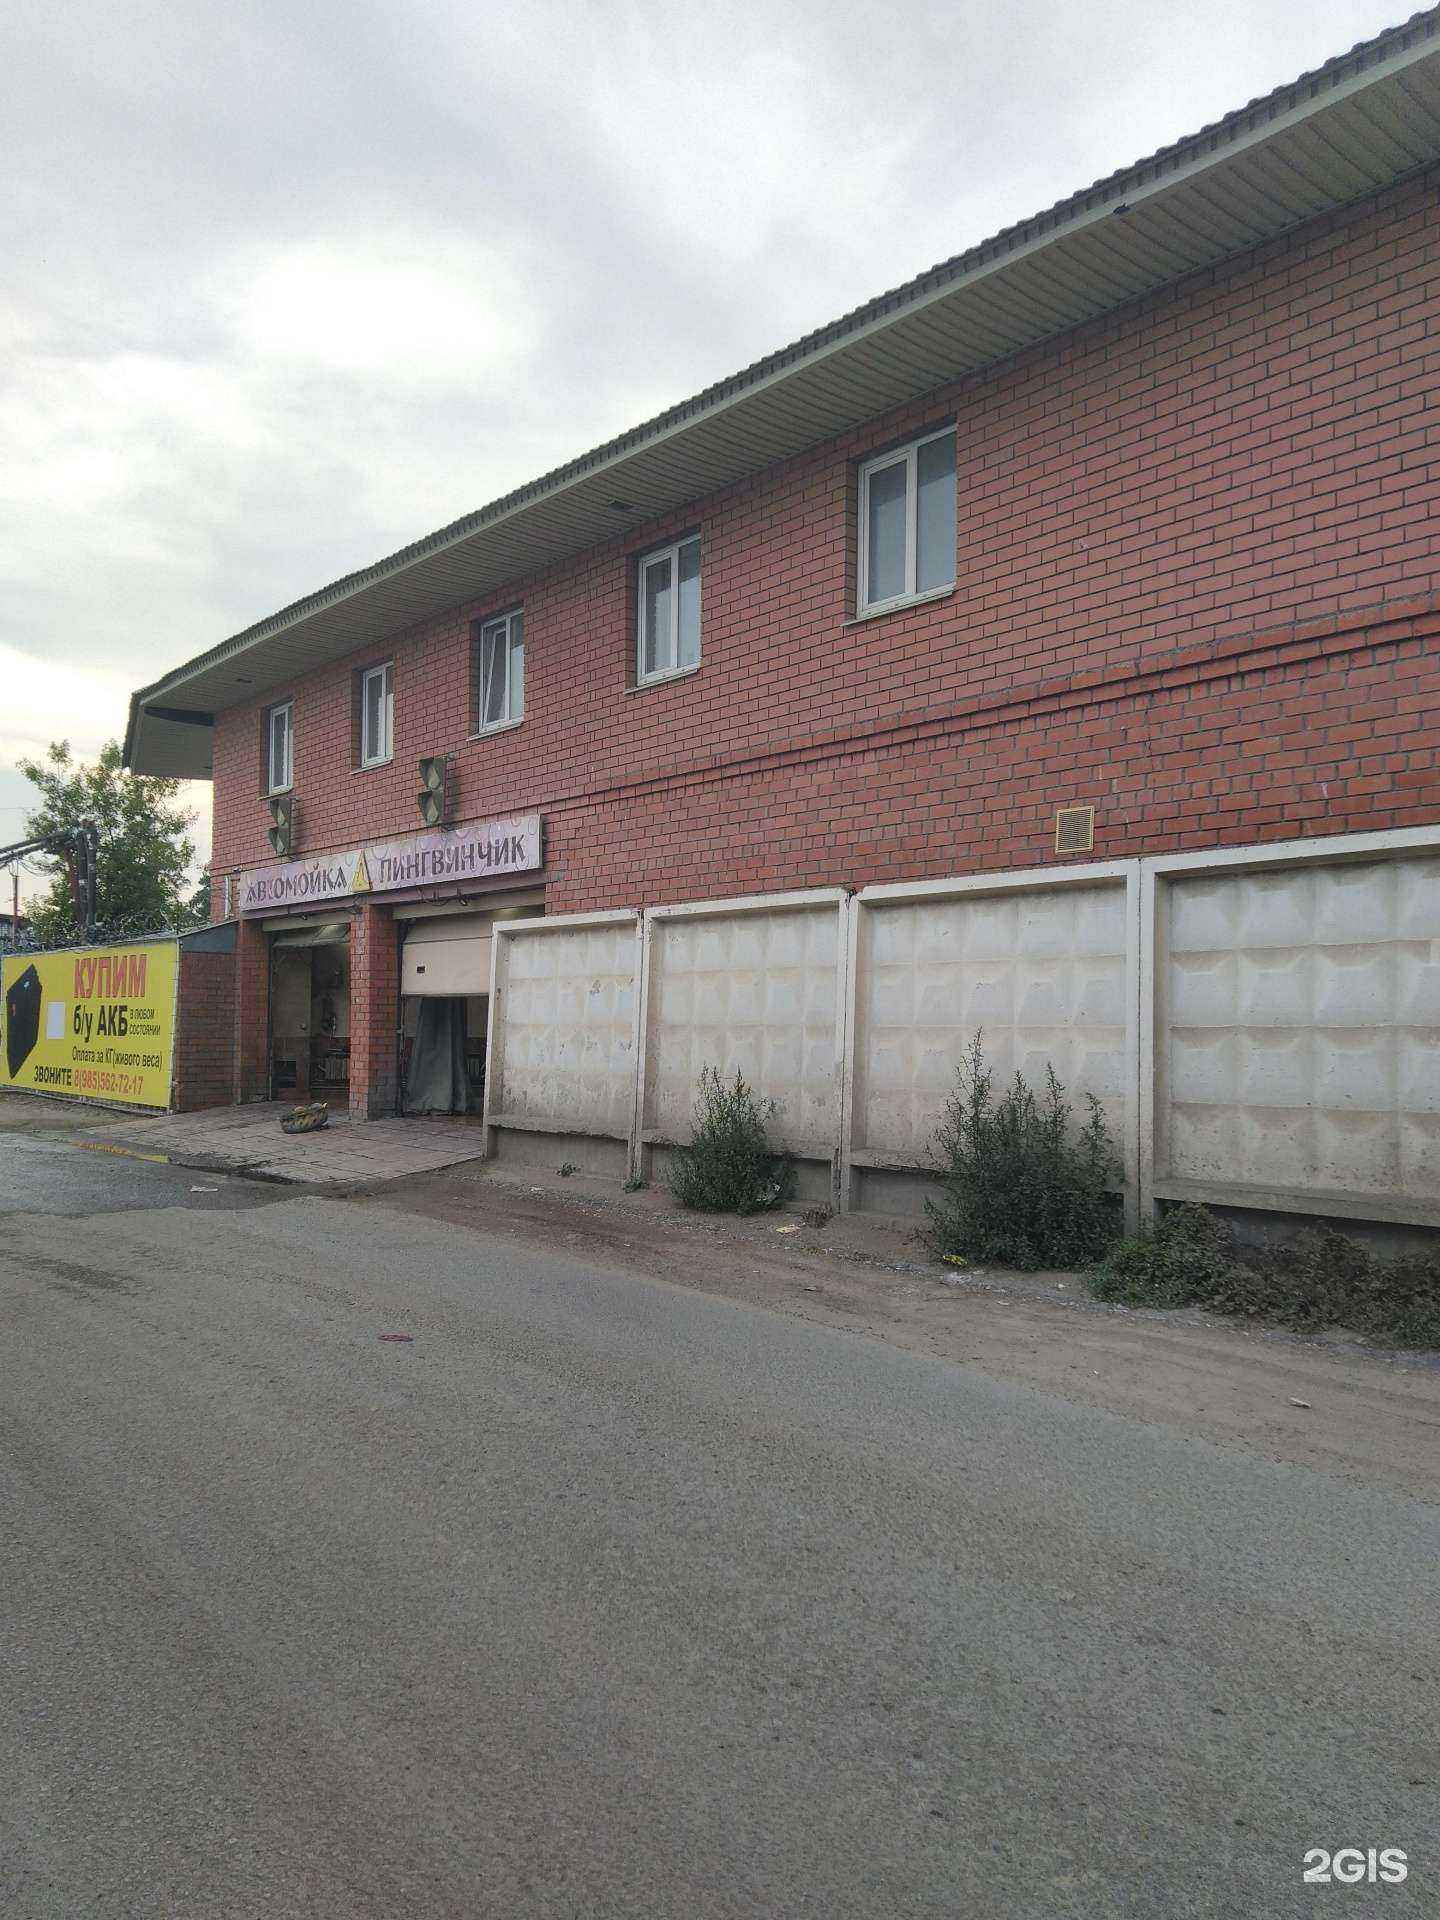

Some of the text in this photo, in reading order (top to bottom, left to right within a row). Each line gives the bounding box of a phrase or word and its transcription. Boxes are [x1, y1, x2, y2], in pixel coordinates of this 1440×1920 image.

[246, 834, 526, 903] АВОМОЙКА ПИНГВИНЧИК
[73, 954, 147, 998] КУПИМ
[73, 1005, 128, 1043] б/у АКБ
[129, 1024, 161, 1036] состоянии
[72, 1046, 96, 1063] Оплата
[96, 1051, 104, 1063] за
[141, 1051, 163, 1072] веса)
[34, 1066, 72, 1086] ЗВОНИТЕ
